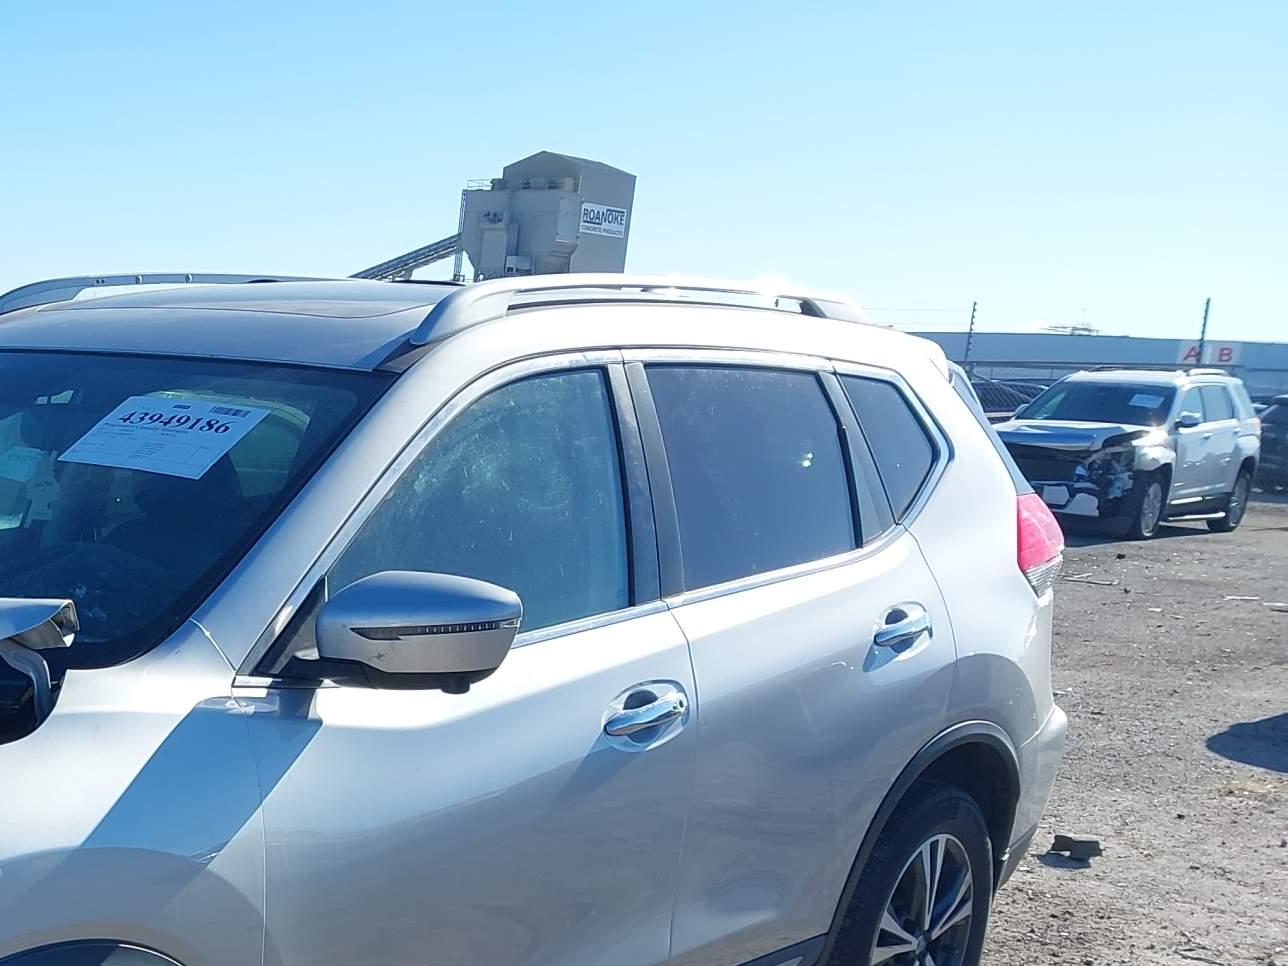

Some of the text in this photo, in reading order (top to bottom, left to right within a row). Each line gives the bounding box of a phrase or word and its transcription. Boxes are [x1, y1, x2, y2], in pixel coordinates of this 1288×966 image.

[582, 207, 625, 226] ROANOKE
[1182, 345, 1234, 362] A B
[117, 410, 237, 435] 43949186
